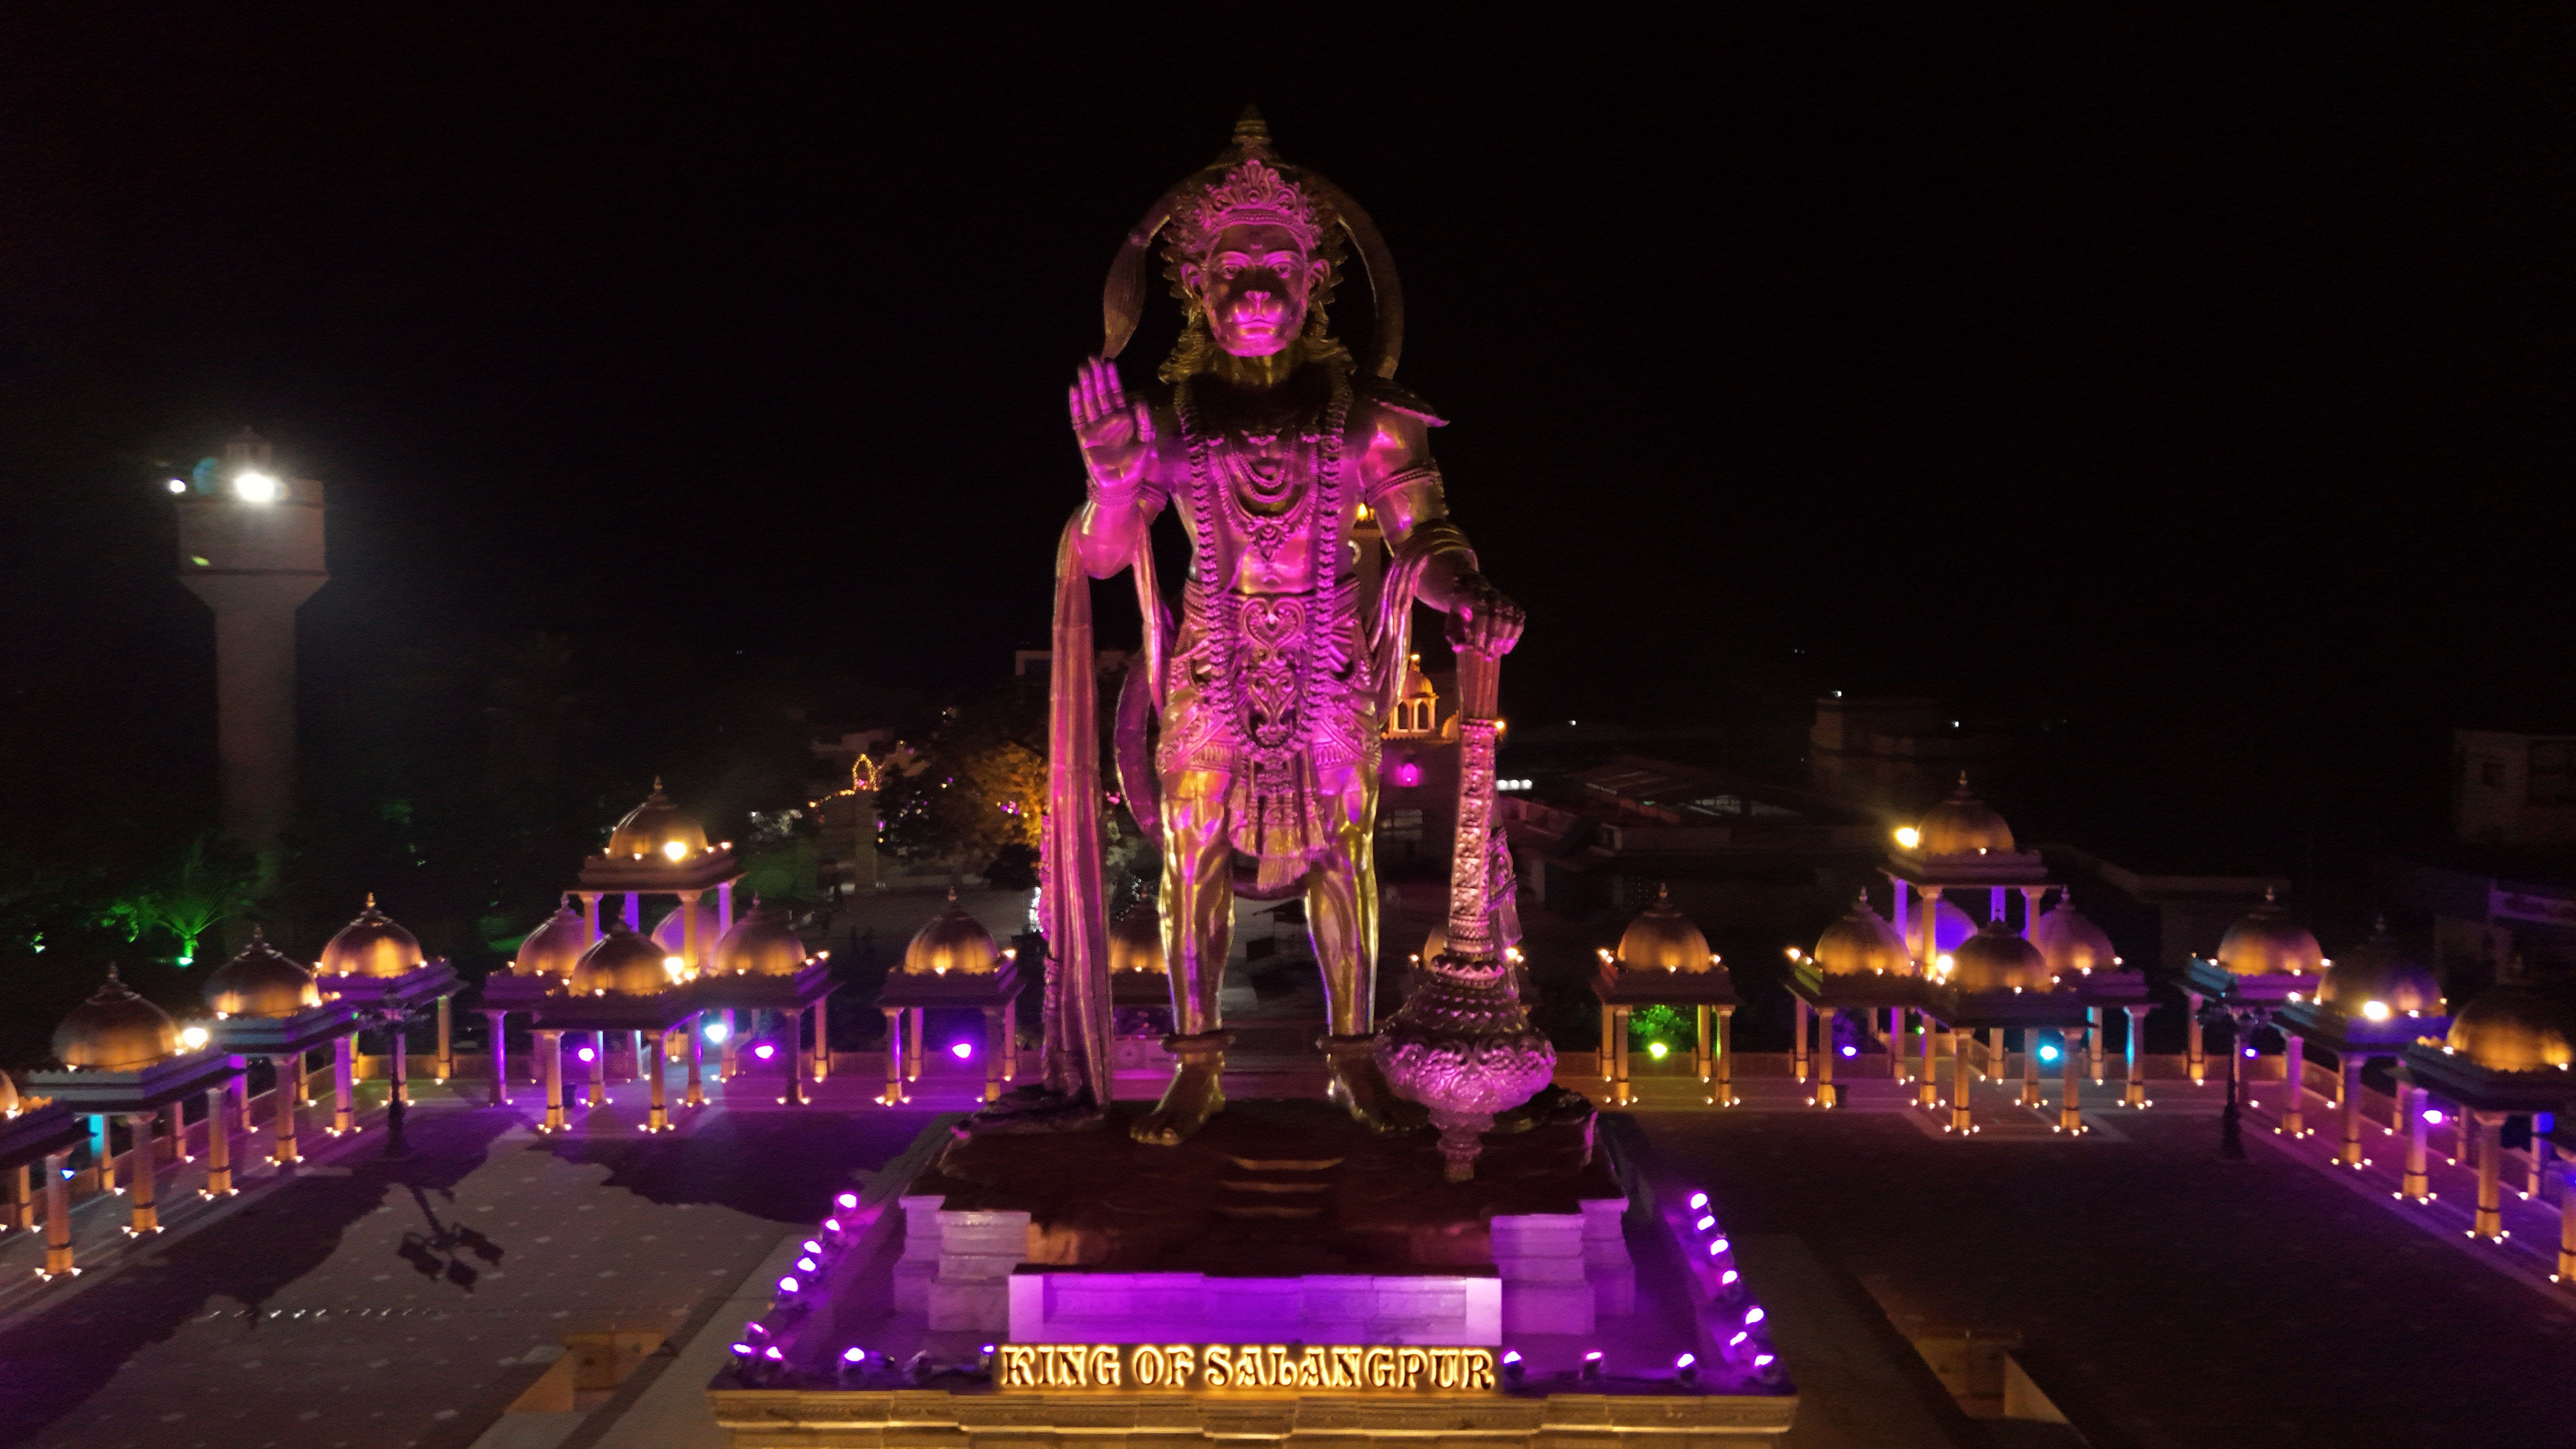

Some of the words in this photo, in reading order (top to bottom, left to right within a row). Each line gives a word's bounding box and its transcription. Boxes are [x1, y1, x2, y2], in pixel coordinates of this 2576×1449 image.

[1002, 1346, 1120, 1387] KING
[1133, 1346, 1194, 1387] OF
[1205, 1346, 1495, 1389] SALANGPUR
